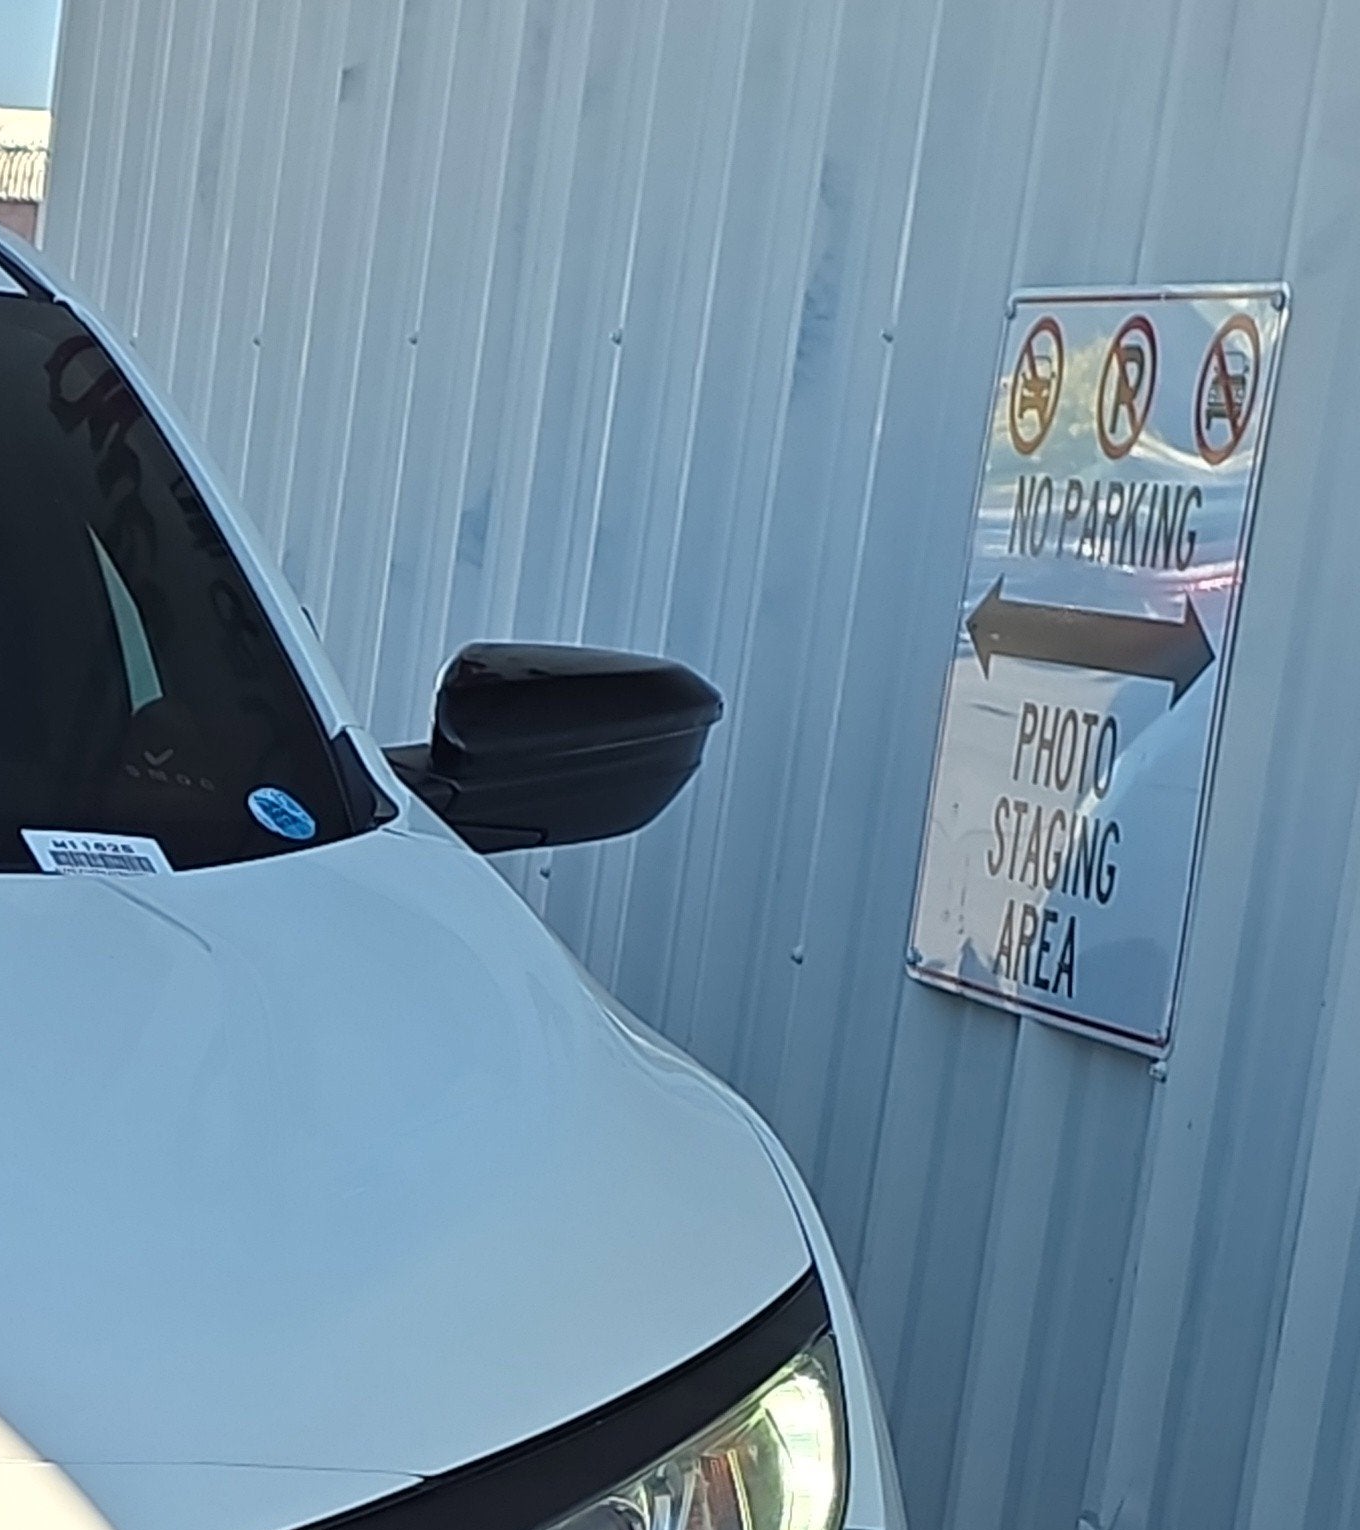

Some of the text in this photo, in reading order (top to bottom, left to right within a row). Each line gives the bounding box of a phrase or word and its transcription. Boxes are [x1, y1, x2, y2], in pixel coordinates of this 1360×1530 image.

[1008, 475, 1203, 571] NO PARKING
[1012, 701, 1118, 800] PHOTO
[986, 796, 1121, 905] STAGING
[992, 899, 1076, 999] AREA
